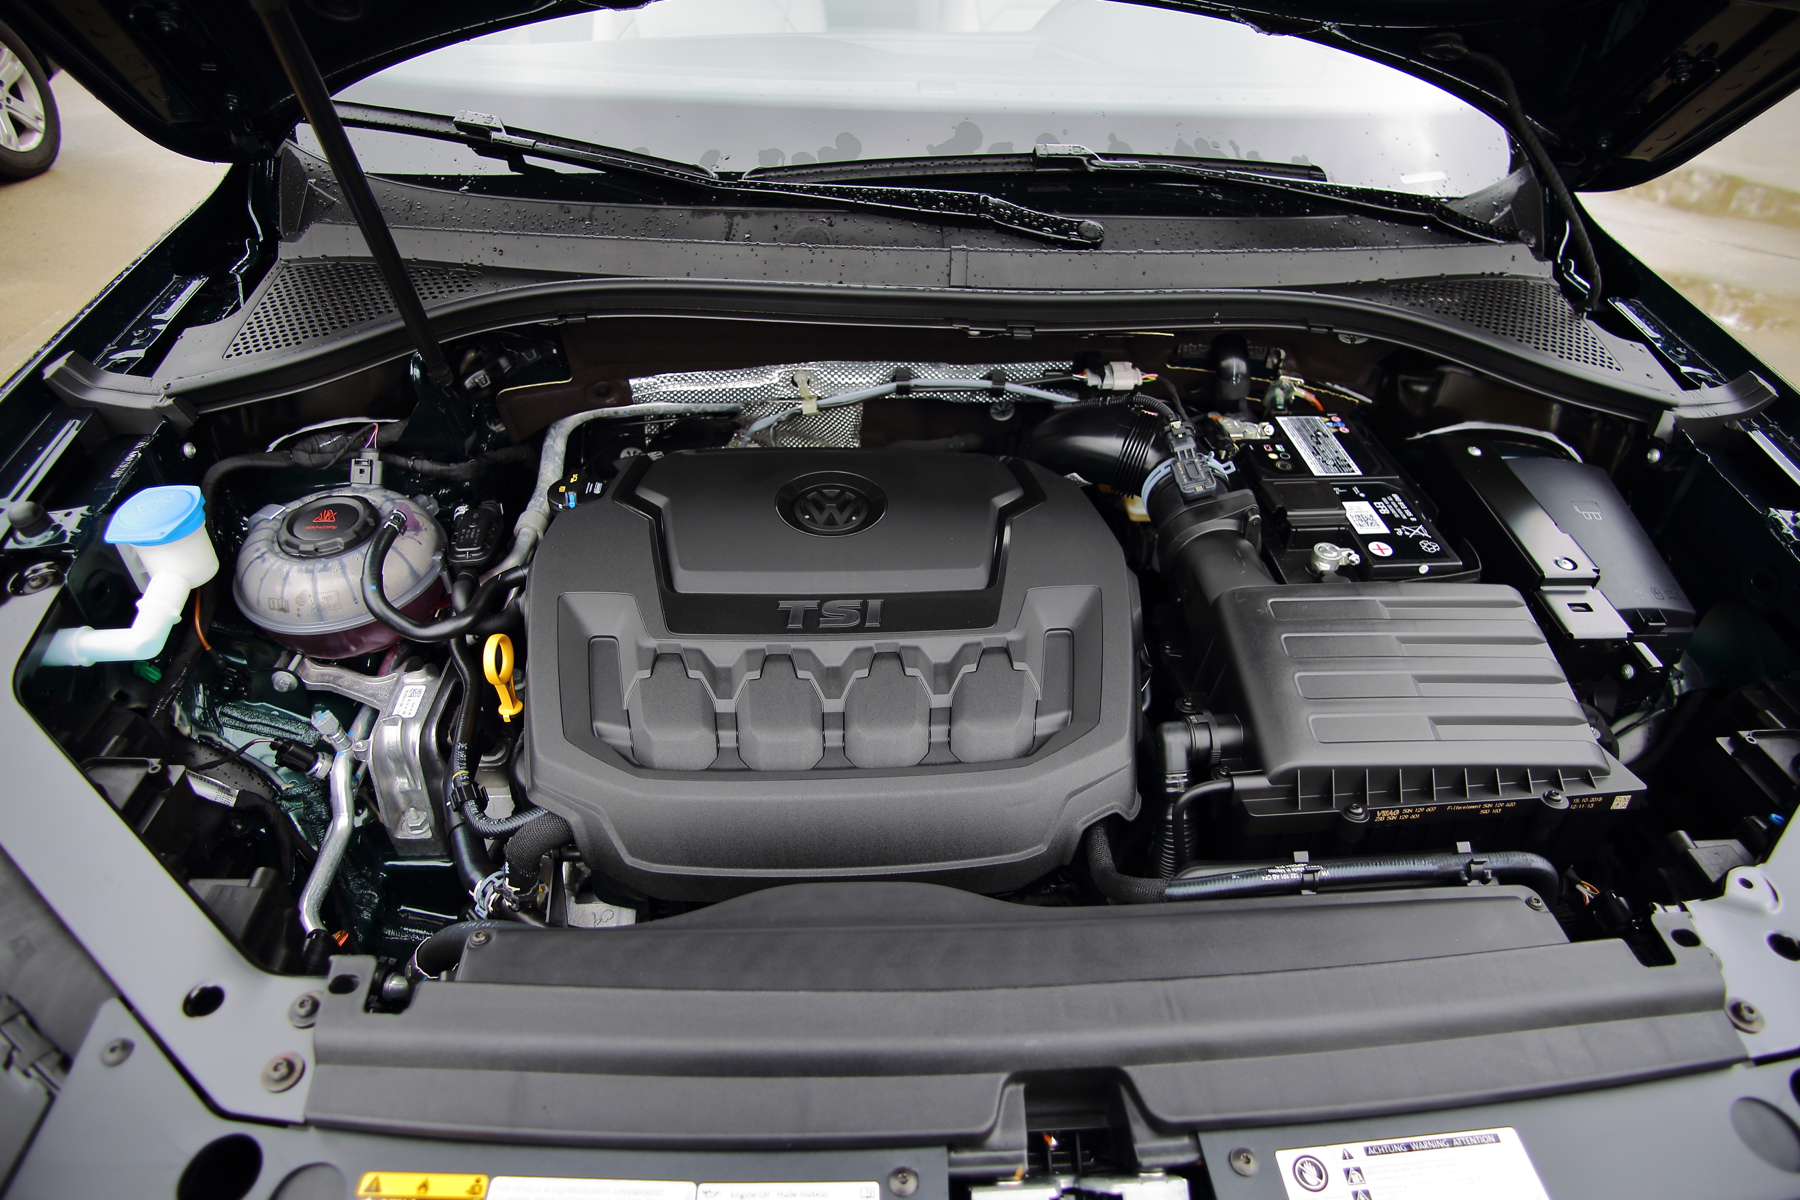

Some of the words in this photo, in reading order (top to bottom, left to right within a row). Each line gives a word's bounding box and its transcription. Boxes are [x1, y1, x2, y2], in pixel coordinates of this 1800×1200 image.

[795, 484, 868, 531] VW
[1373, 501, 1391, 514] EFB
[777, 599, 884, 629] TSI
[1368, 1142, 1407, 1156] ACHTUNG
[1410, 1138, 1450, 1151] WARNING
[1453, 1133, 1495, 1147] ATTENTION
[731, 1190, 756, 1199] Engine
